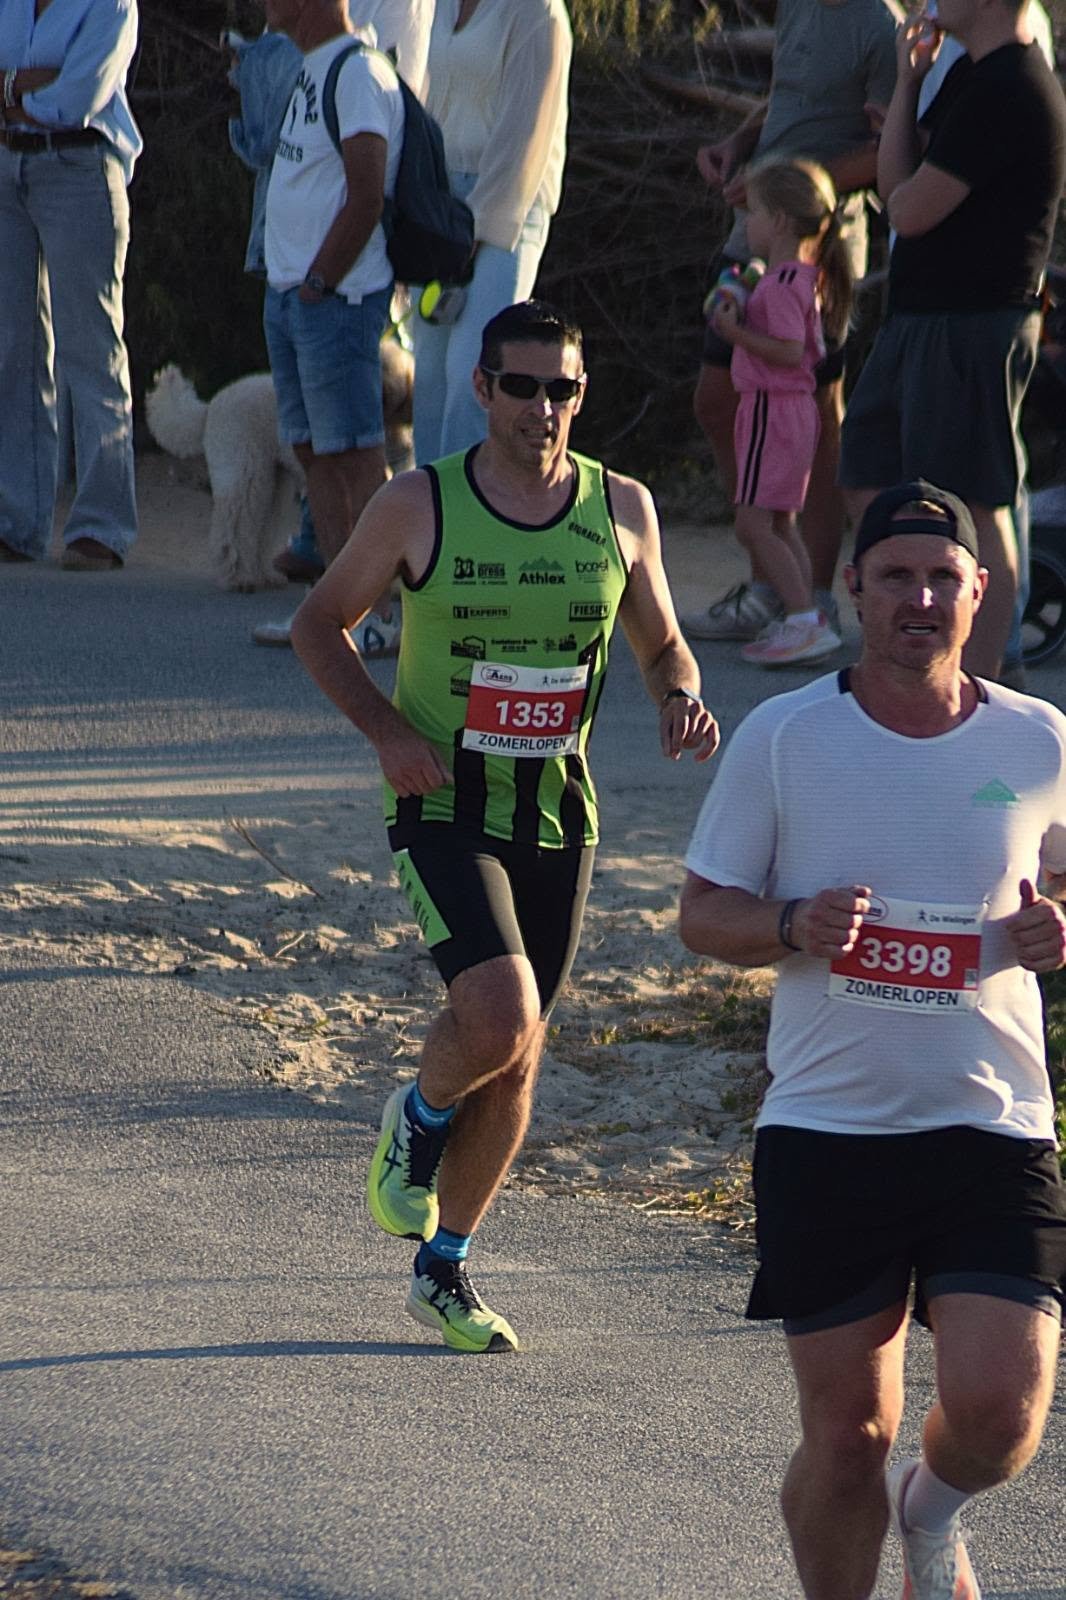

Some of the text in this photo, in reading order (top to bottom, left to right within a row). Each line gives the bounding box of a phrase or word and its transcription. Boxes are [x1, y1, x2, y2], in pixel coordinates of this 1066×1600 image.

[518, 571, 566, 585] Athlex
[469, 608, 508, 617] EXPERTS
[495, 700, 566, 728] 1353
[478, 733, 568, 750] ZOMERLOPEN
[859, 937, 952, 977] 3398
[845, 978, 960, 1006] ZOMERLOPEN
